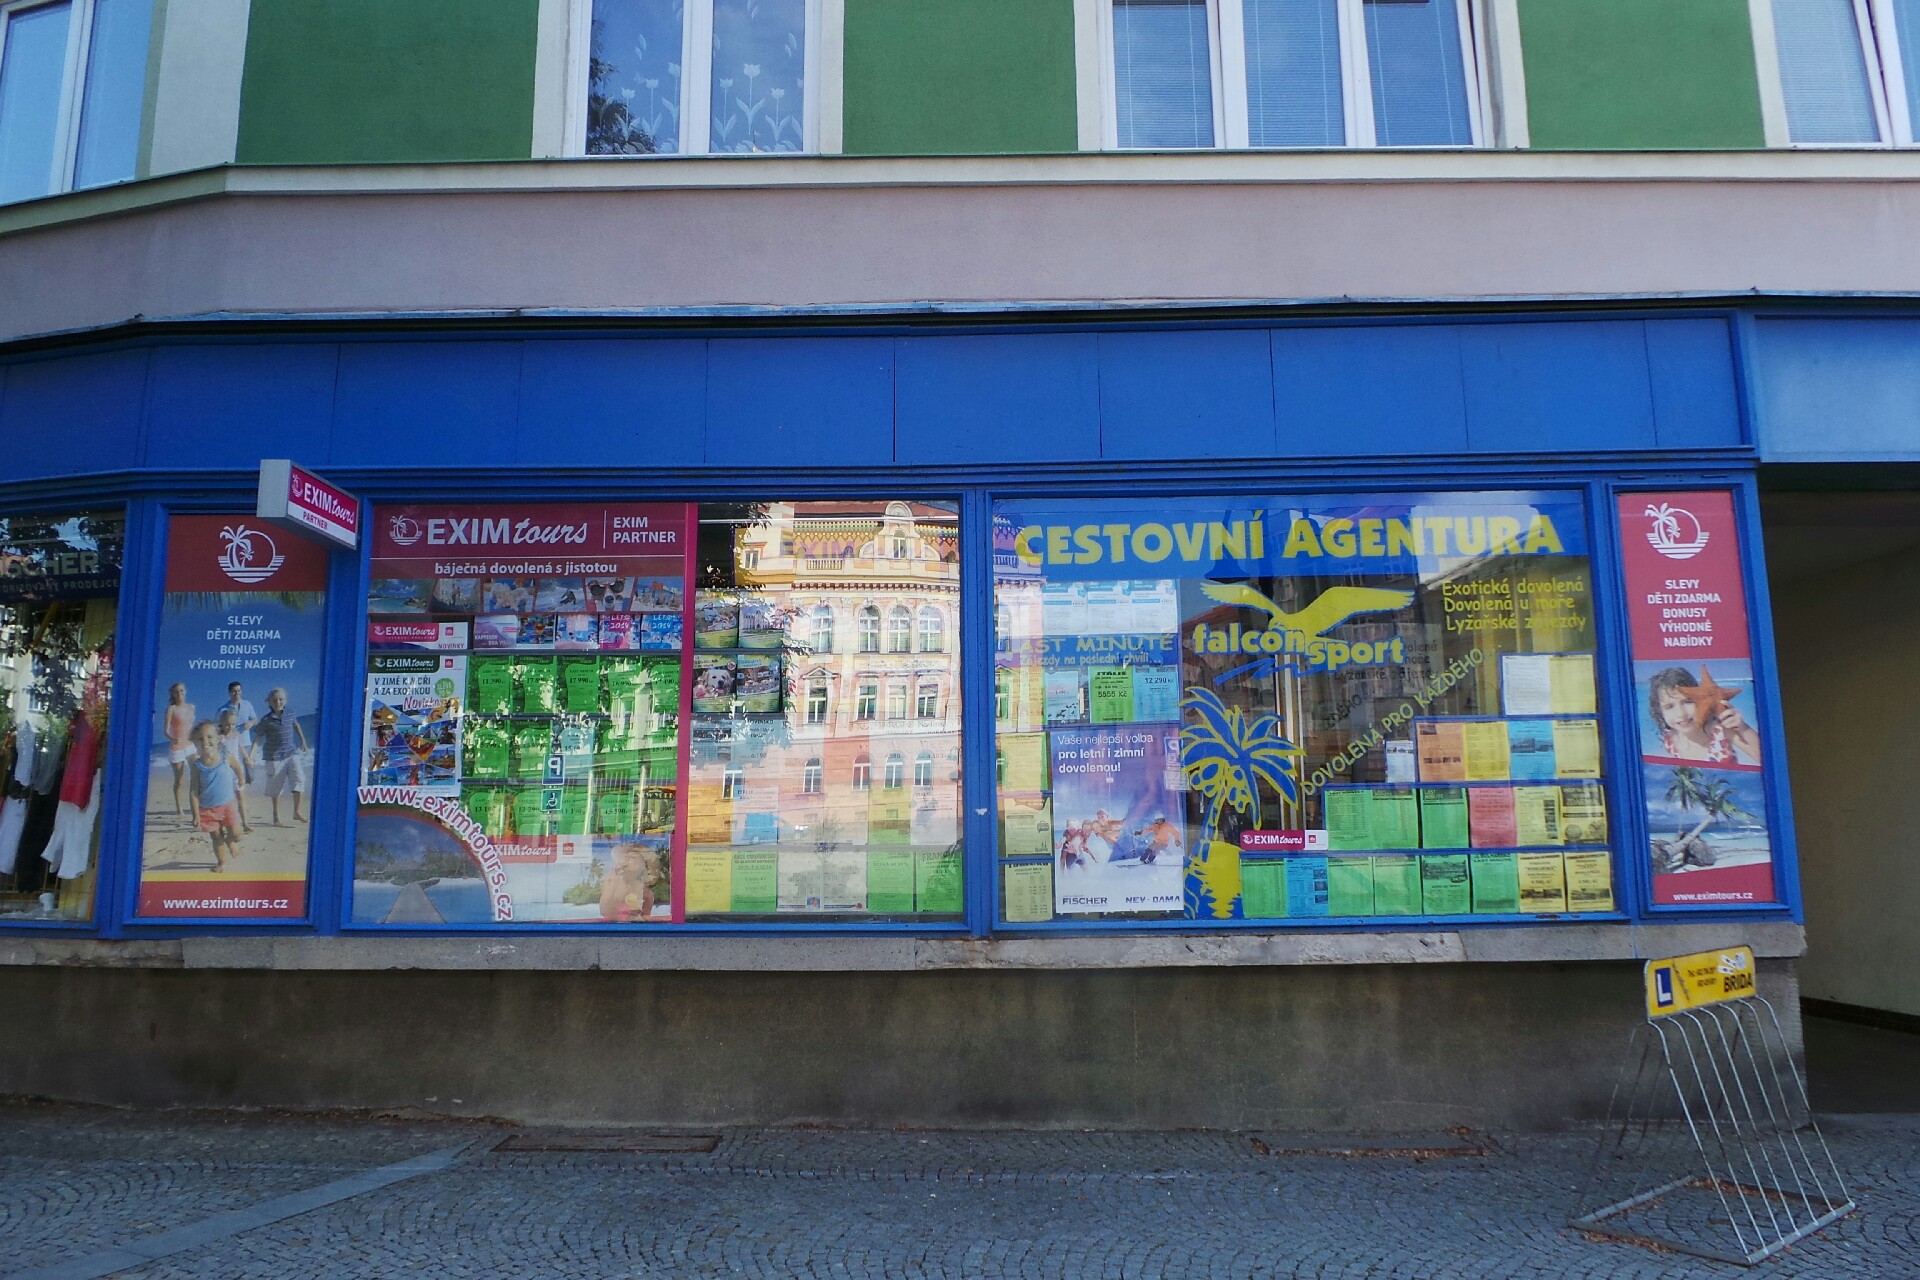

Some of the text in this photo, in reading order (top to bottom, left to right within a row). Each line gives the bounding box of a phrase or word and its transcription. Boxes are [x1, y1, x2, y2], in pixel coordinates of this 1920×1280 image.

[303, 511, 328, 530] PARTNER
[613, 516, 648, 529] EXIM
[612, 531, 676, 544] PARTNER
[1014, 510, 1565, 566] CESTOVNÍ AGENTURA
[435, 561, 618, 576] báječná dovolená s jistotou
[1442, 576, 1584, 596] Exotická dovolená
[1665, 579, 1700, 590] SLEVY
[1444, 595, 1513, 613] Dovolená
[1520, 602, 1529, 610] u
[1647, 592, 1722, 604] DĚTI ZDARMA
[1663, 608, 1707, 618] BONUSY
[227, 615, 264, 626] SLEVY
[1446, 613, 1517, 635] Lyžařské
[1659, 620, 1713, 633] VÝHODNÉ
[206, 628, 281, 640] DĚTI ZDARMA
[1664, 634, 1713, 647] NABÍDKY
[220, 645, 265, 655] BONUSY
[1076, 634, 1174, 653] MINUTE
[1193, 622, 1405, 670] falcon sport
[188, 656, 296, 669] VÝHODNÉ NABÍDKY
[1080, 652, 1120, 666] poslední
[374, 677, 380, 685] V
[1300, 647, 1484, 796] DOVOLENÁ PRO KAŽDÉHO
[1057, 733, 1154, 746] Vaše nejlepší volba
[1058, 747, 1144, 762] pro letní i zimní
[1058, 761, 1121, 773] dovolenou!
[360, 787, 512, 919] www.eximtours.cz
[494, 843, 552, 856] XIMtours
[1062, 897, 1108, 905] FISCHER
[1672, 890, 1754, 902] www.eximtours.cz
[163, 896, 289, 911] www.eximtours.cz
